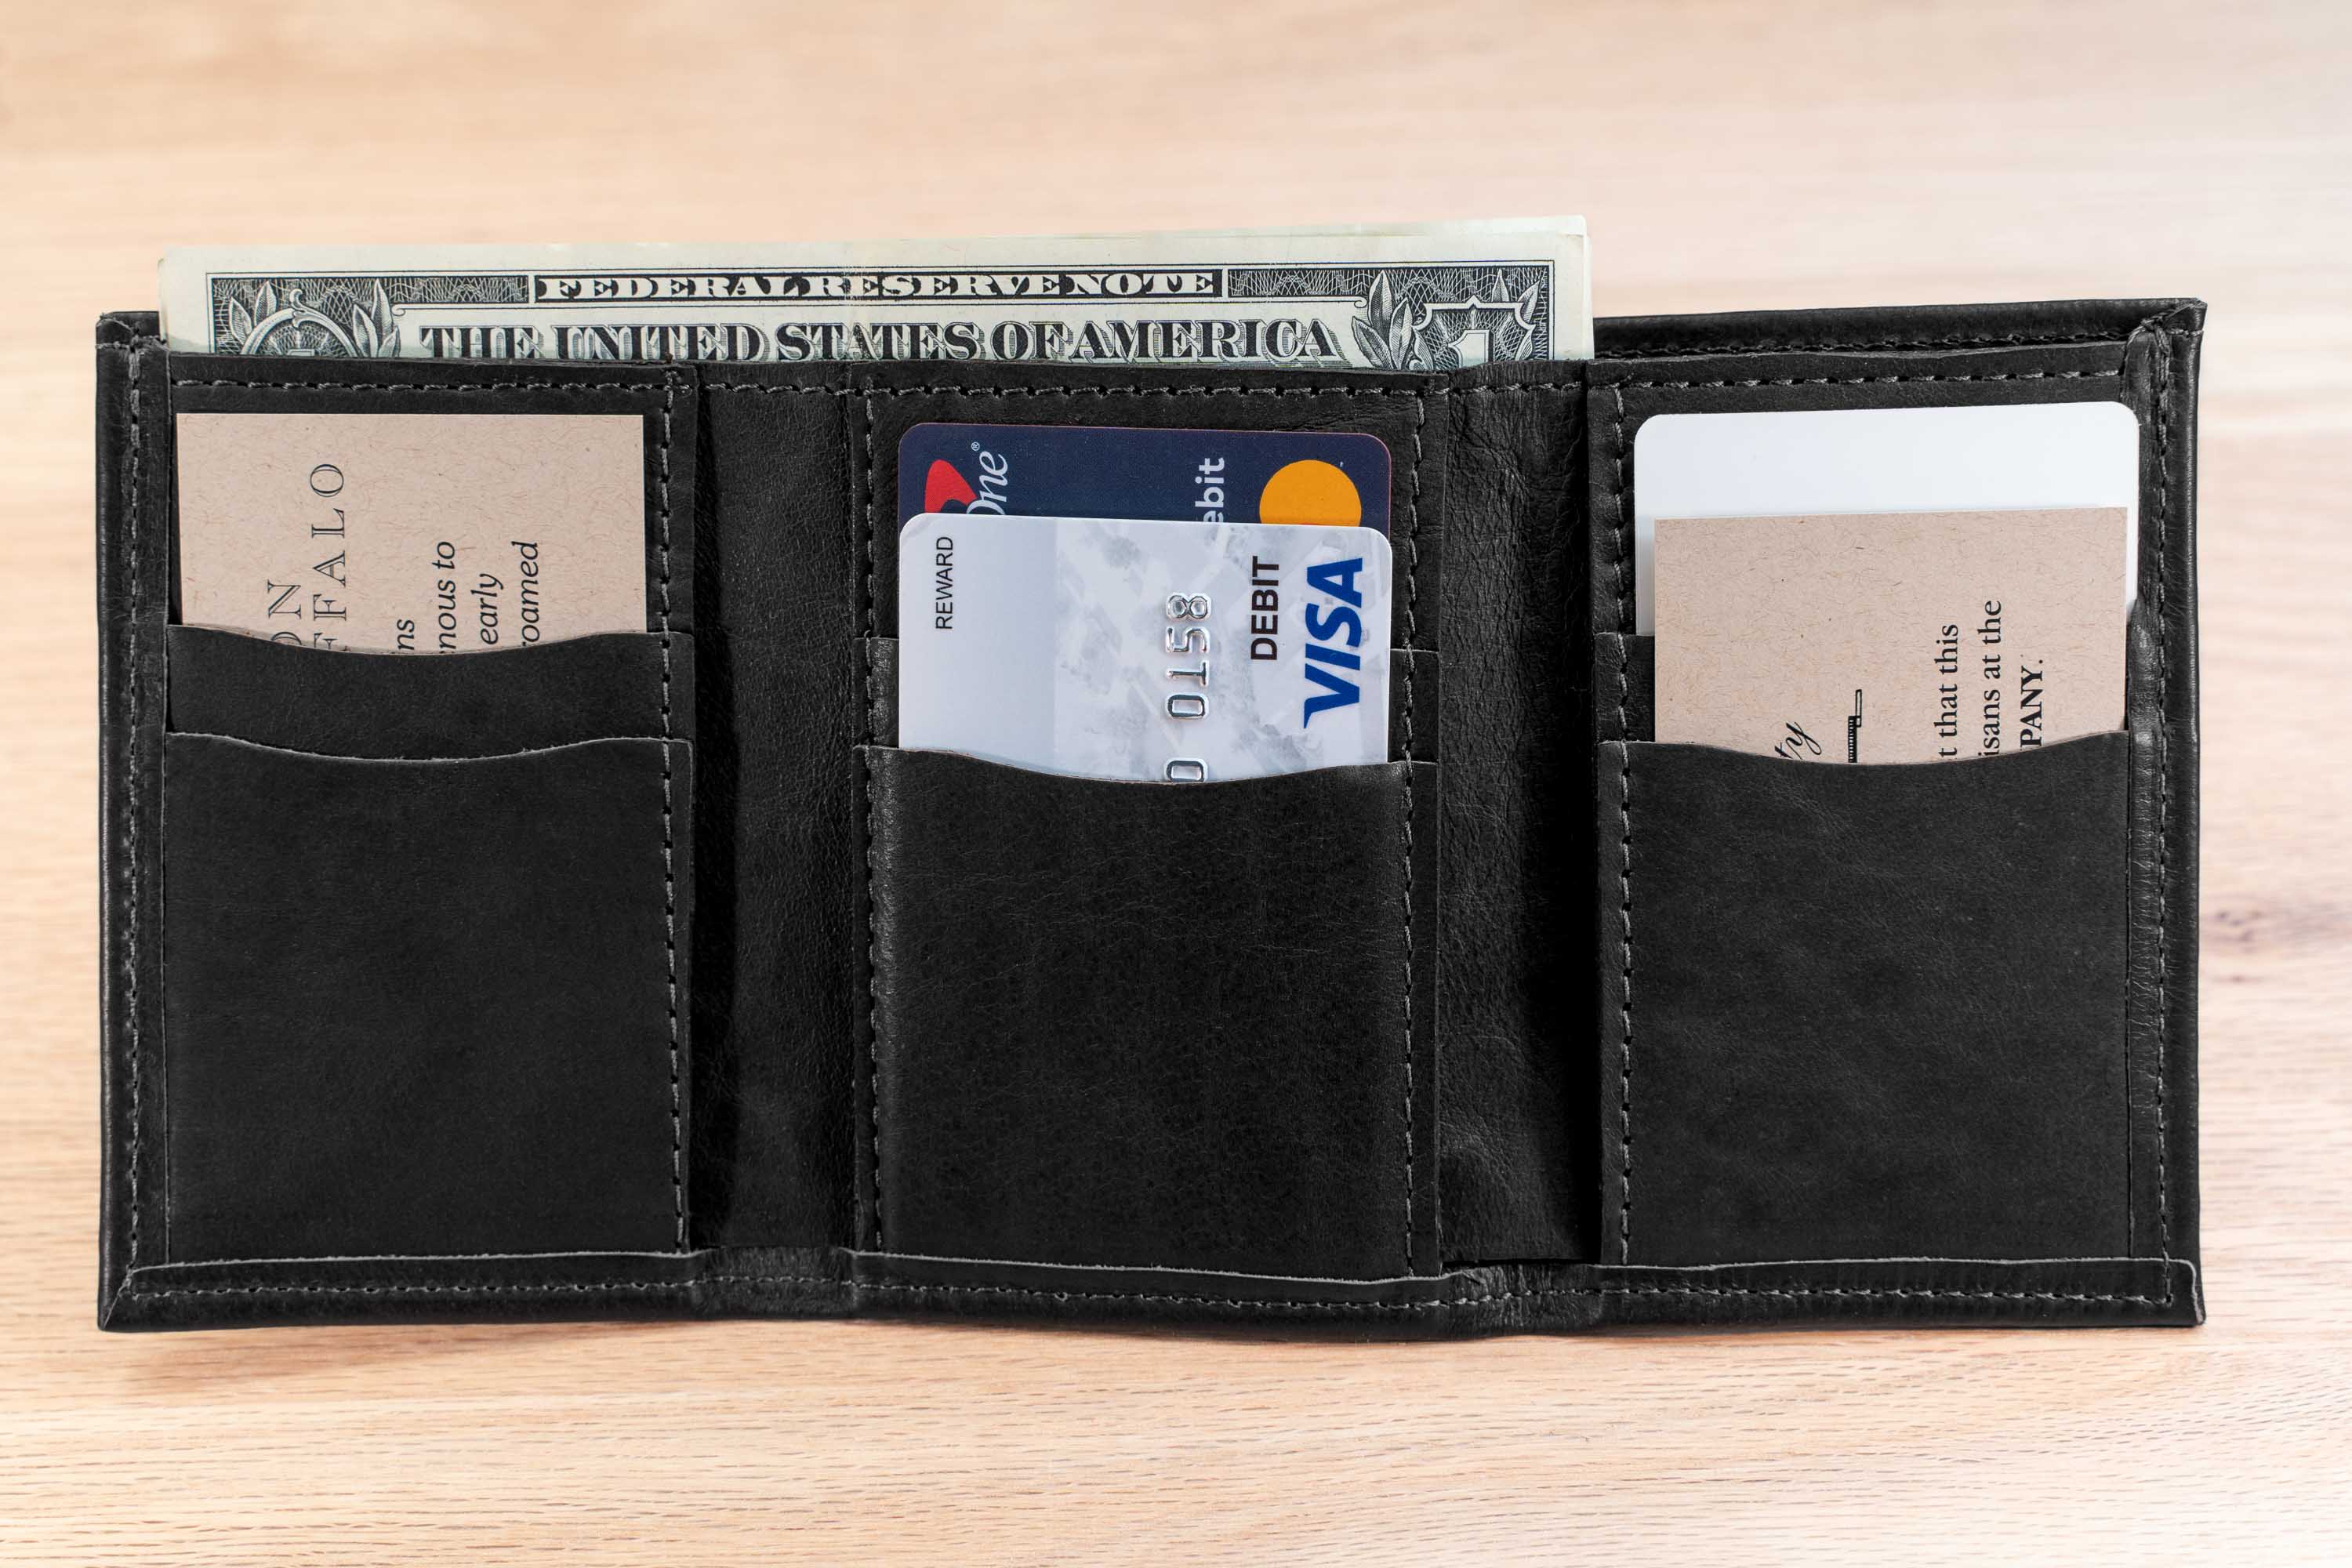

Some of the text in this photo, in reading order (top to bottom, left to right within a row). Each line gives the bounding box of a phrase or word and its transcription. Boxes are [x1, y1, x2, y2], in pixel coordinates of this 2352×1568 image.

[538, 273, 1214, 299] FEDERAL RESERVE NOTE
[419, 318, 1353, 366] THE UNITED STATES OF AMERICA
[432, 541, 456, 654] nous to
[470, 573, 503, 645] early
[511, 540, 540, 647] oamed
[936, 536, 953, 630] REWARD
[1251, 556, 1279, 661] DEBIT
[392, 619, 415, 654] ns
[1304, 557, 1363, 729] VISA
[1933, 624, 1958, 675] this
[1976, 601, 2002, 645] the
[1166, 593, 1211, 719] 0158
[1982, 654, 2001, 679] at
[1933, 684, 1958, 738] that
